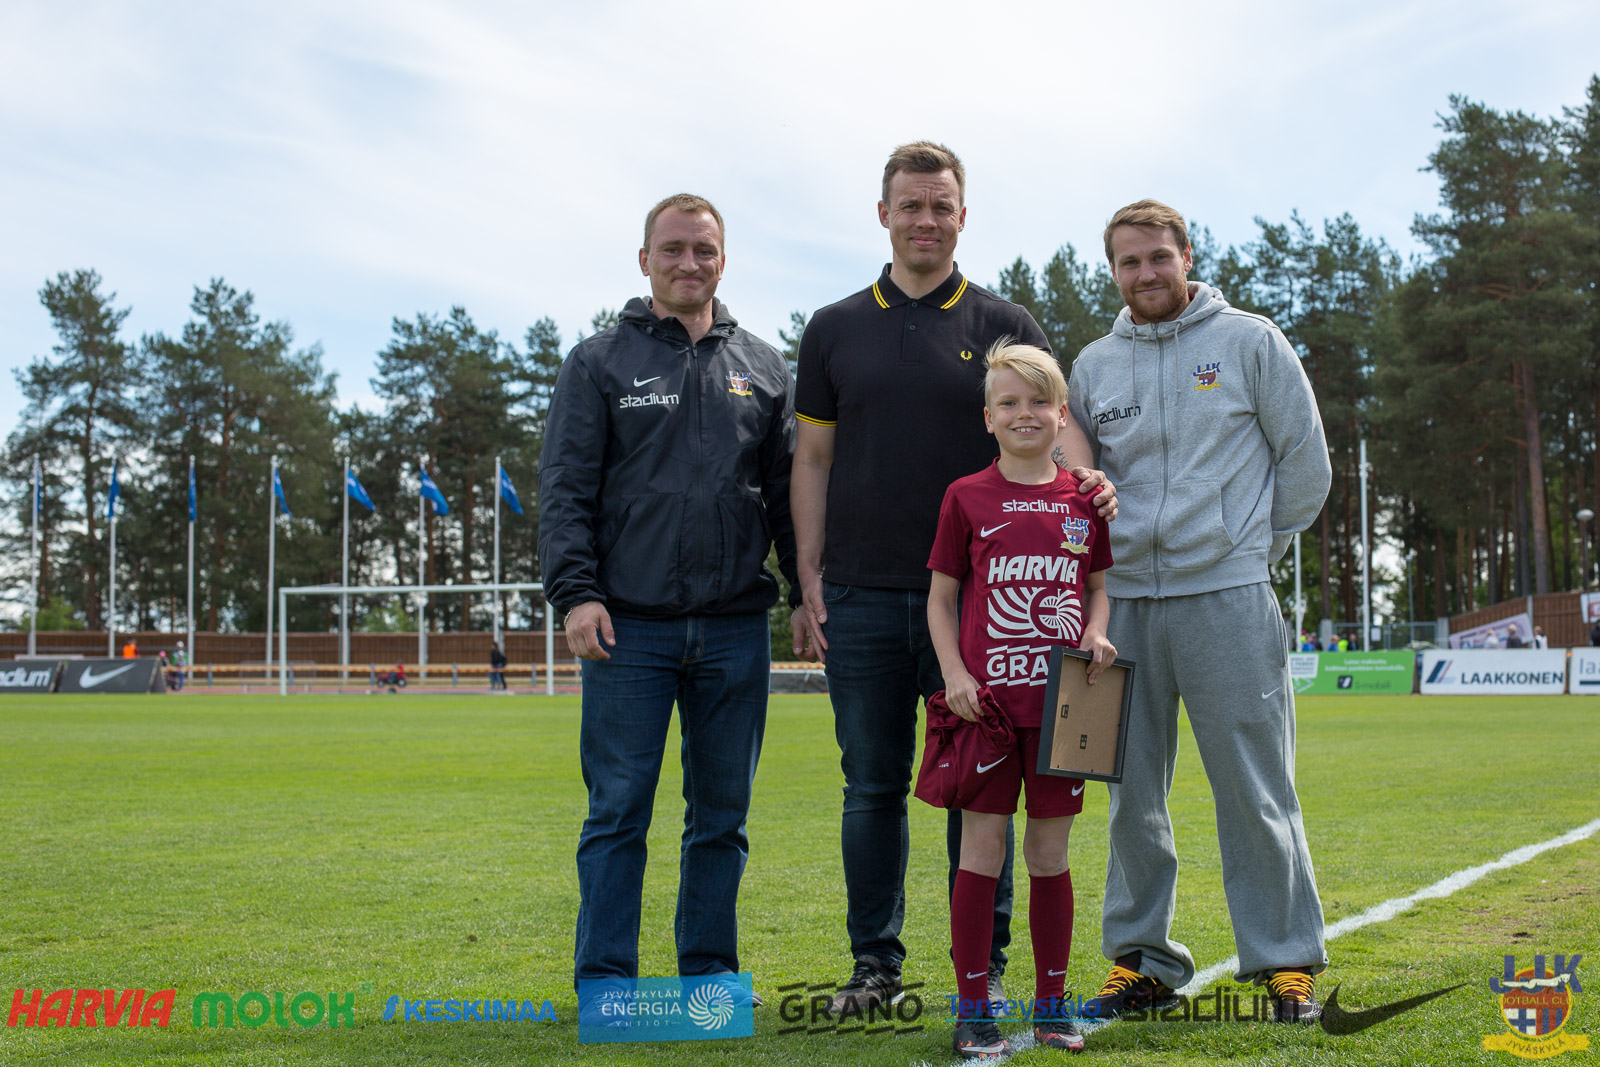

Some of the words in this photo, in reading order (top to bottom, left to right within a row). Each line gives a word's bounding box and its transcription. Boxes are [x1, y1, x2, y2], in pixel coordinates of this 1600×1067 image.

[619, 393, 679, 409] stadium
[1092, 405, 1142, 425] tadium
[1002, 499, 1070, 514] stadium
[987, 555, 1080, 584] HARVIA
[986, 654, 1049, 679] GRA
[1580, 656, 1600, 673] la
[1461, 672, 1563, 685] LAAKKONEN
